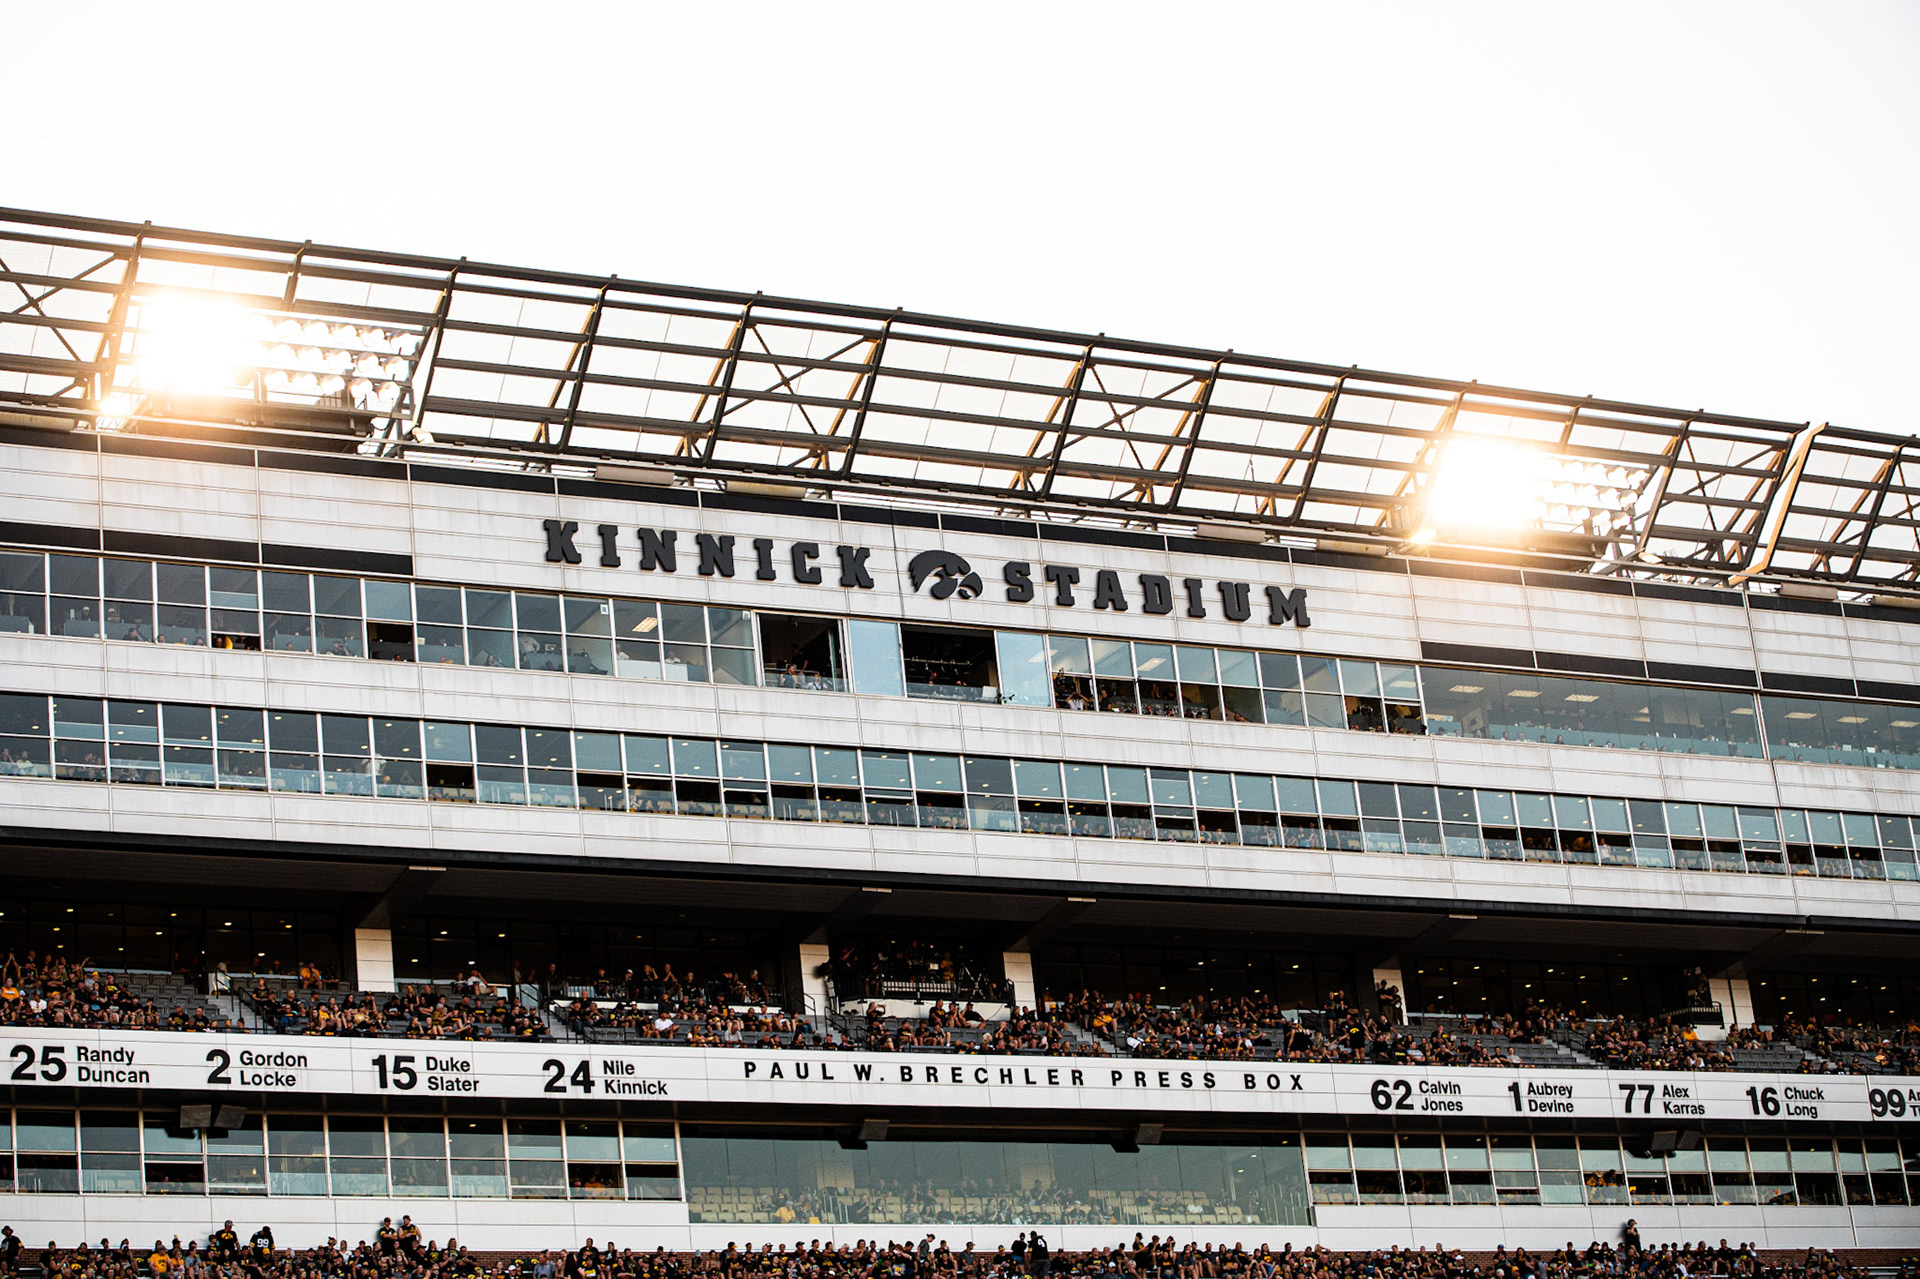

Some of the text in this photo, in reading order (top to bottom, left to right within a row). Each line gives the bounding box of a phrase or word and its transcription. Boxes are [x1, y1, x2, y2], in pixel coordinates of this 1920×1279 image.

[543, 519, 1311, 629] KINNICK STADIUM
[9, 1044, 67, 1081] 25
[77, 1046, 135, 1066] Randy
[239, 1050, 308, 1067] Gordon
[426, 1056, 471, 1072] Duke
[77, 1066, 150, 1083] Duncan
[206, 1048, 231, 1084] 2
[371, 1054, 418, 1091] 15
[602, 1060, 635, 1076] Nile
[240, 1070, 297, 1087] Locke
[427, 1075, 480, 1092] Slater
[542, 1058, 596, 1094] 24
[743, 1061, 835, 1081] PAUL
[899, 1065, 1084, 1086] BRECHLER
[1110, 1070, 1216, 1089] PRESS
[1243, 1073, 1303, 1091] BOX
[604, 1079, 668, 1095] Kinnick
[1371, 1079, 1415, 1111] 62
[1418, 1080, 1462, 1095] Calvin
[1527, 1082, 1573, 1099] Aubrey
[1662, 1084, 1690, 1098] Alex
[1783, 1086, 1825, 1101] Chuck
[1421, 1097, 1464, 1112] Jones
[1507, 1081, 1523, 1112] 1
[1618, 1083, 1655, 1114] 77
[1745, 1086, 1781, 1117] 16
[1869, 1088, 1906, 1118] 99
[1528, 1098, 1574, 1113] Devine
[1662, 1101, 1706, 1115] Karras
[1786, 1103, 1819, 1120] Long
[1909, 1105, 1920, 1117] T
[256, 1238, 270, 1248] 99
